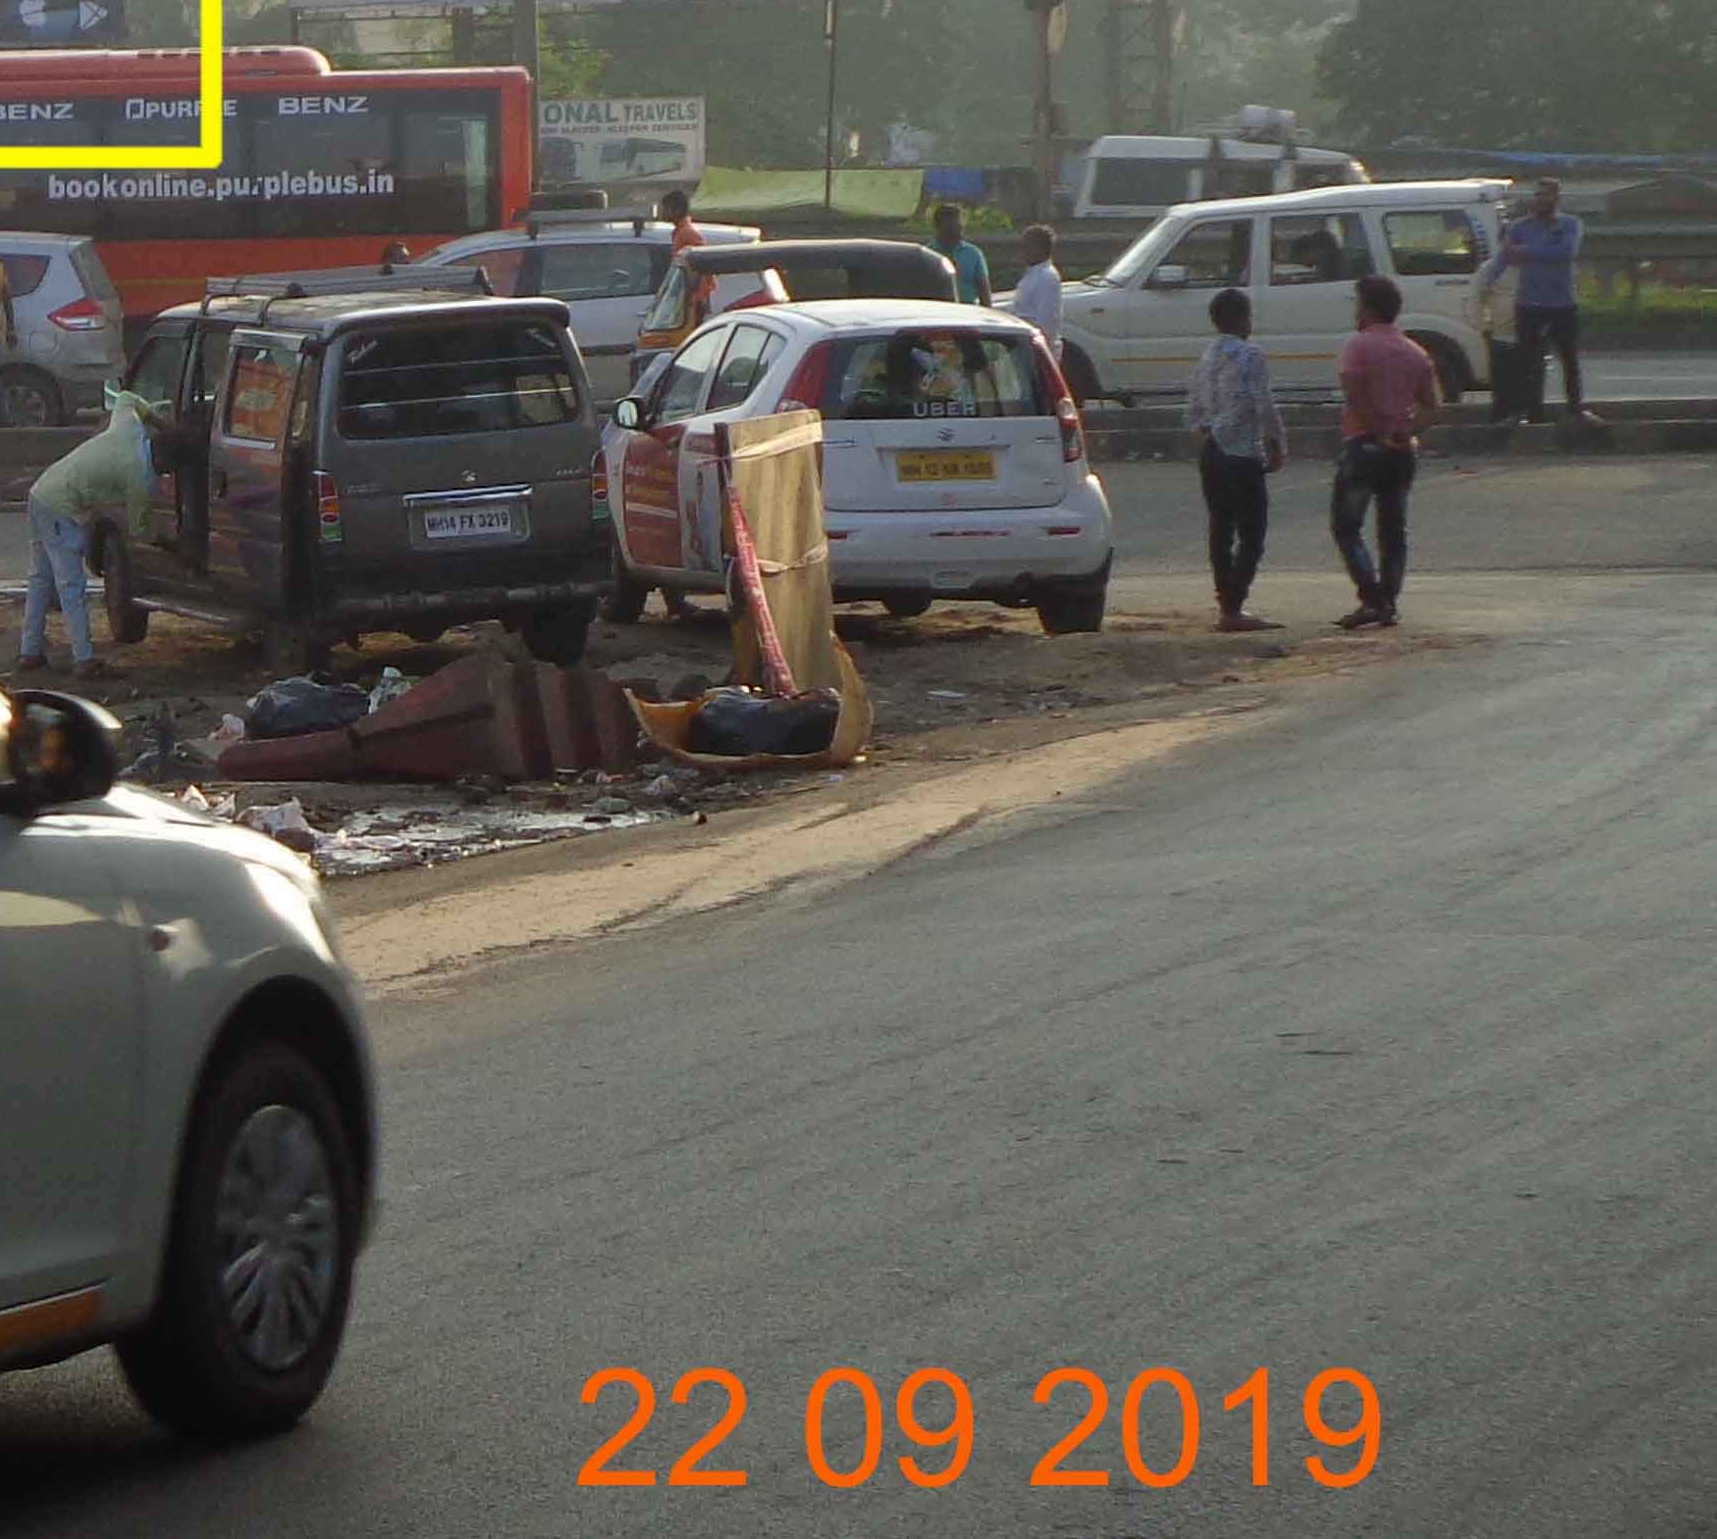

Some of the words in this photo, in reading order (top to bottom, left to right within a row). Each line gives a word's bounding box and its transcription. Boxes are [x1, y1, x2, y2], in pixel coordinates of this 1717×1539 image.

[144, 98, 238, 119] PURPE
[277, 96, 370, 117] BENZ
[623, 101, 696, 123] TRAVELS
[913, 401, 976, 417] UBER
